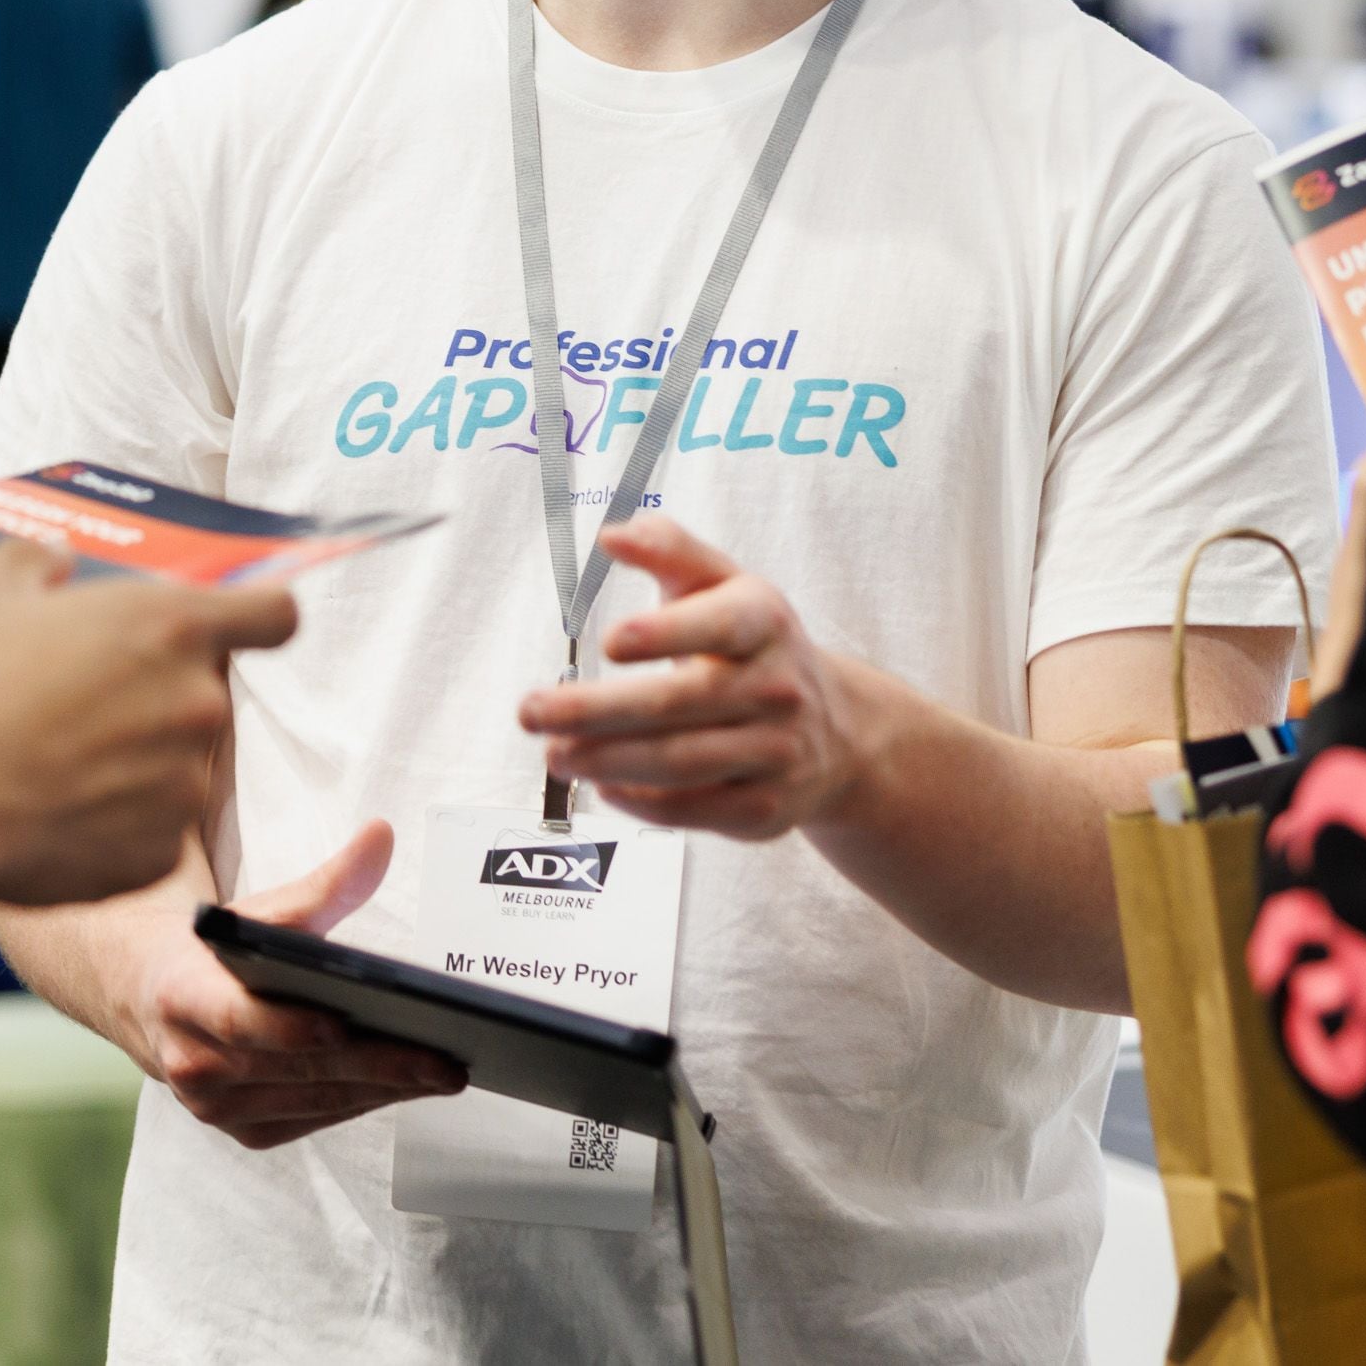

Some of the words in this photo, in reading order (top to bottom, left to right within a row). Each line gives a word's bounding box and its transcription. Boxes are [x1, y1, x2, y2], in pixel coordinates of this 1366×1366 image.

[444, 327, 798, 373] Professinal
[335, 376, 527, 459] GAP
[597, 376, 906, 468] FLLER
[495, 851, 604, 890] ADX
[501, 907, 518, 916] SEE
[522, 909, 541, 918] BUY
[545, 910, 576, 921] LEARN
[502, 891, 595, 909] MELBOURNE
[445, 952, 475, 972] Mr
[483, 955, 566, 985] Wesley
[574, 963, 638, 989] Pryor
